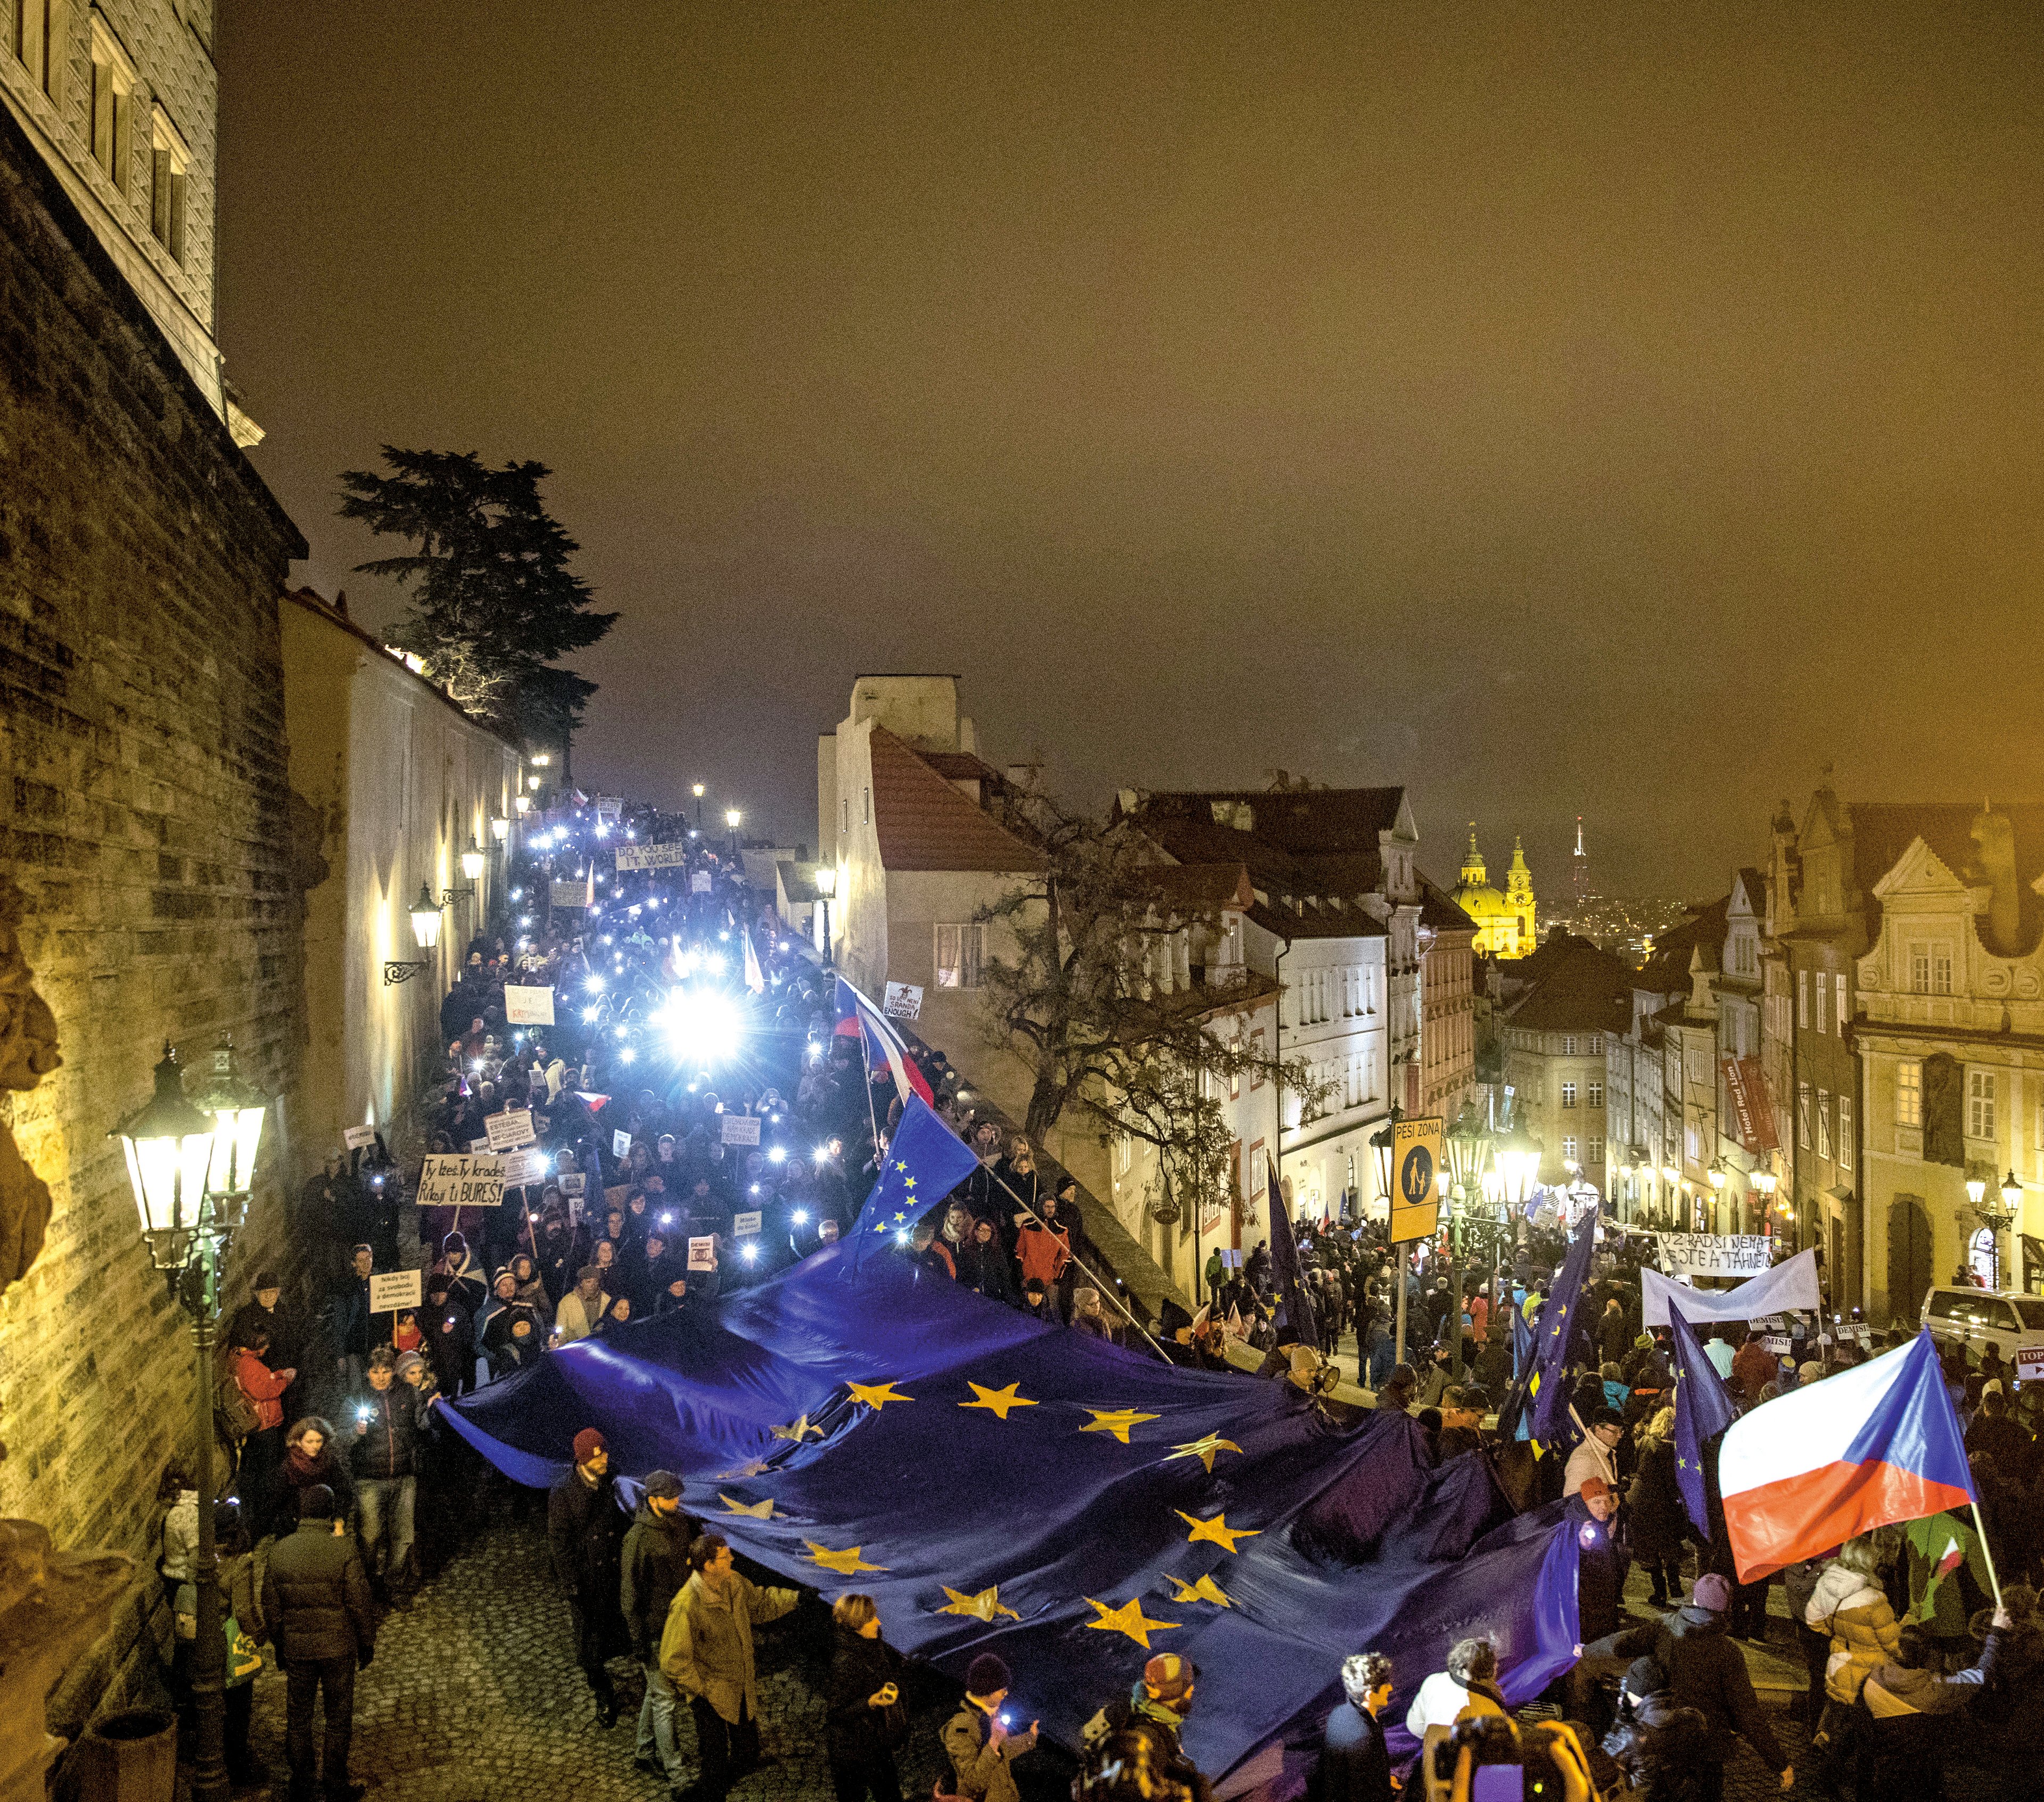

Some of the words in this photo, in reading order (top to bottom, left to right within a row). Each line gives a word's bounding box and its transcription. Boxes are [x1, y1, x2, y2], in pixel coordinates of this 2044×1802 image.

[619, 848, 633, 856] DO
[639, 845, 658, 855] YOU
[662, 844, 681, 852] SEE
[645, 852, 684, 866] WORLD
[889, 1001, 915, 1010] SRANDA
[1728, 1066, 1738, 1085] Lion
[1734, 1089, 1745, 1106] Red
[1740, 1109, 1753, 1134] Hotel
[426, 1159, 436, 1179] Ty
[460, 1159, 471, 1179] Ty
[450, 1183, 458, 1202] ti
[461, 1179, 504, 1203] BUREŠ!
[1837, 1324, 1869, 1334] DEMISI!
[1766, 1336, 1791, 1346] MISI!
